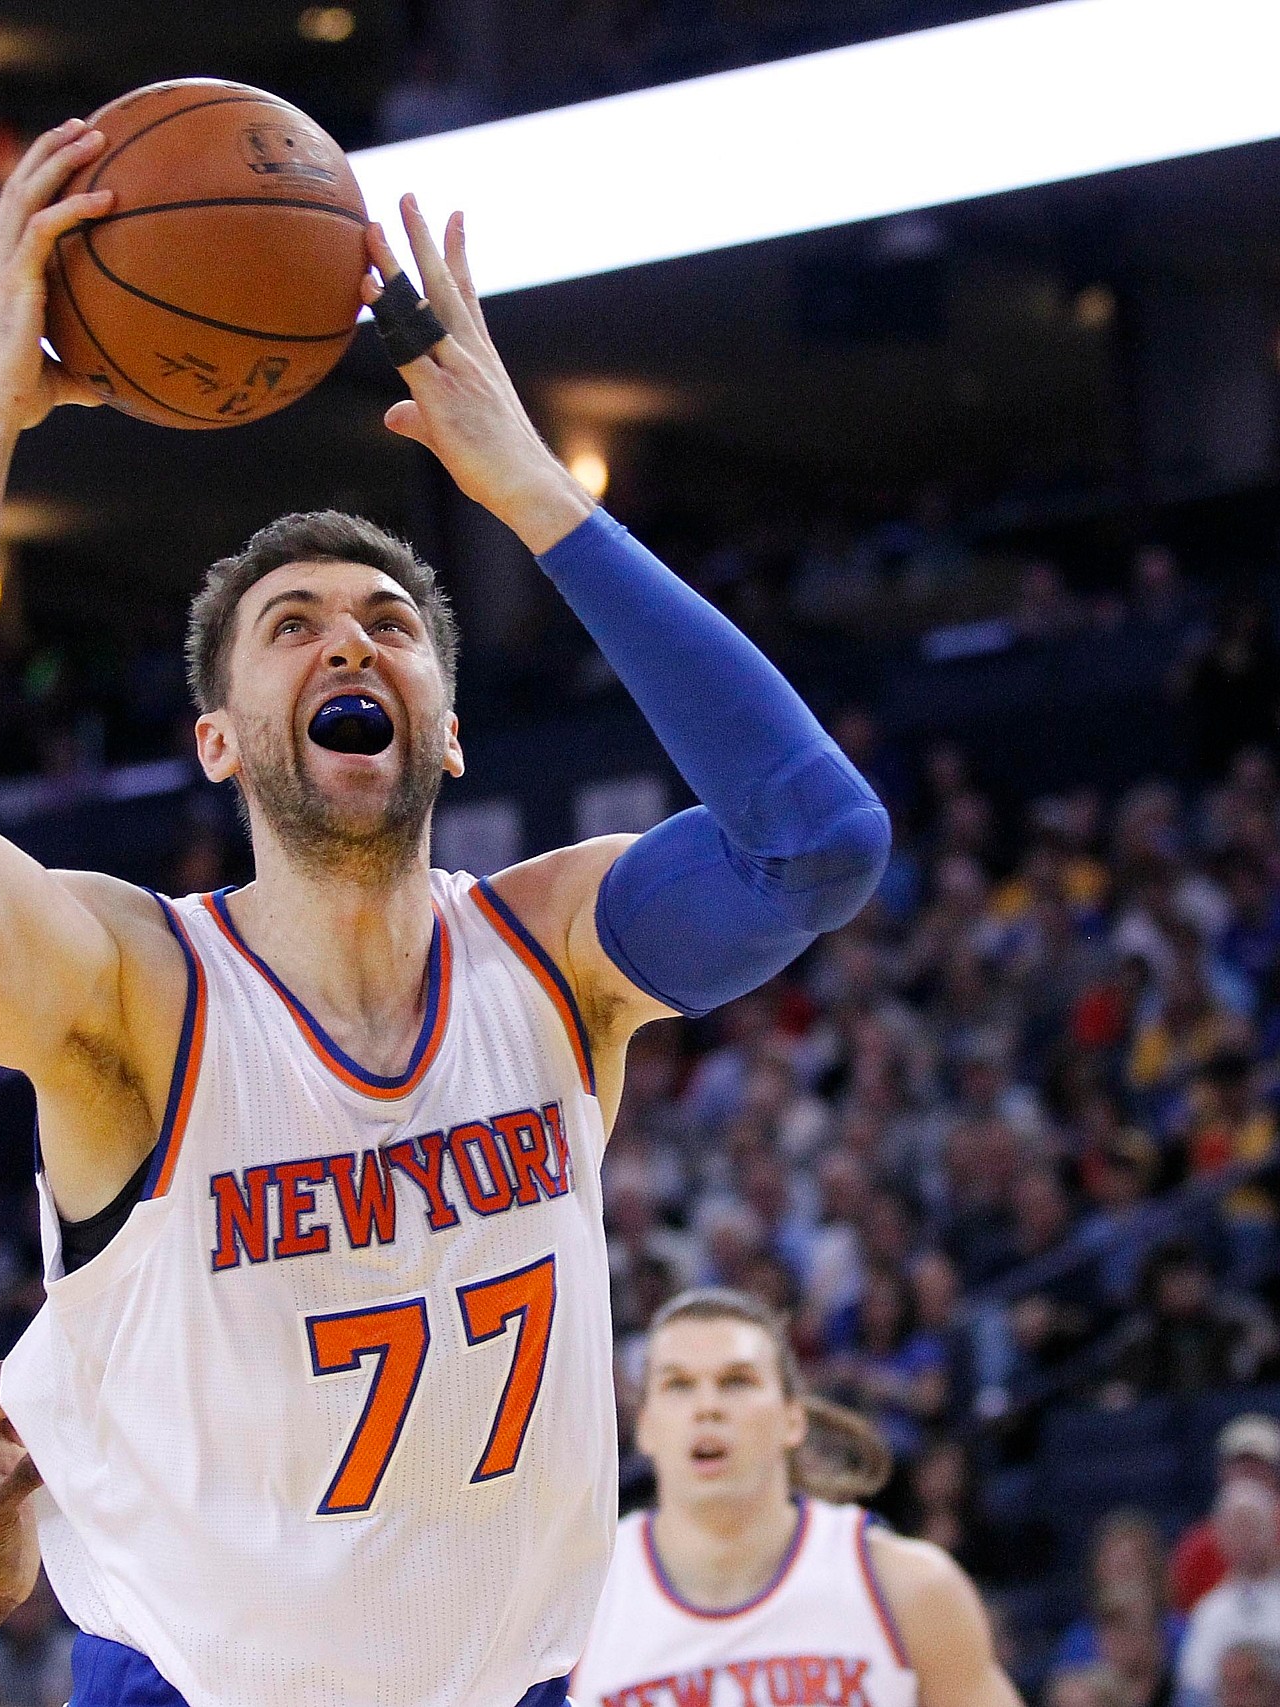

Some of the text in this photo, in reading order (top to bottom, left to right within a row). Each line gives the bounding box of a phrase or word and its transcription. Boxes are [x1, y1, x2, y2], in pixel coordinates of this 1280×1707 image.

[210, 1149, 397, 1273] NEW
[298, 1250, 559, 1520] 77
[600, 1655, 871, 1707] EW YORK
